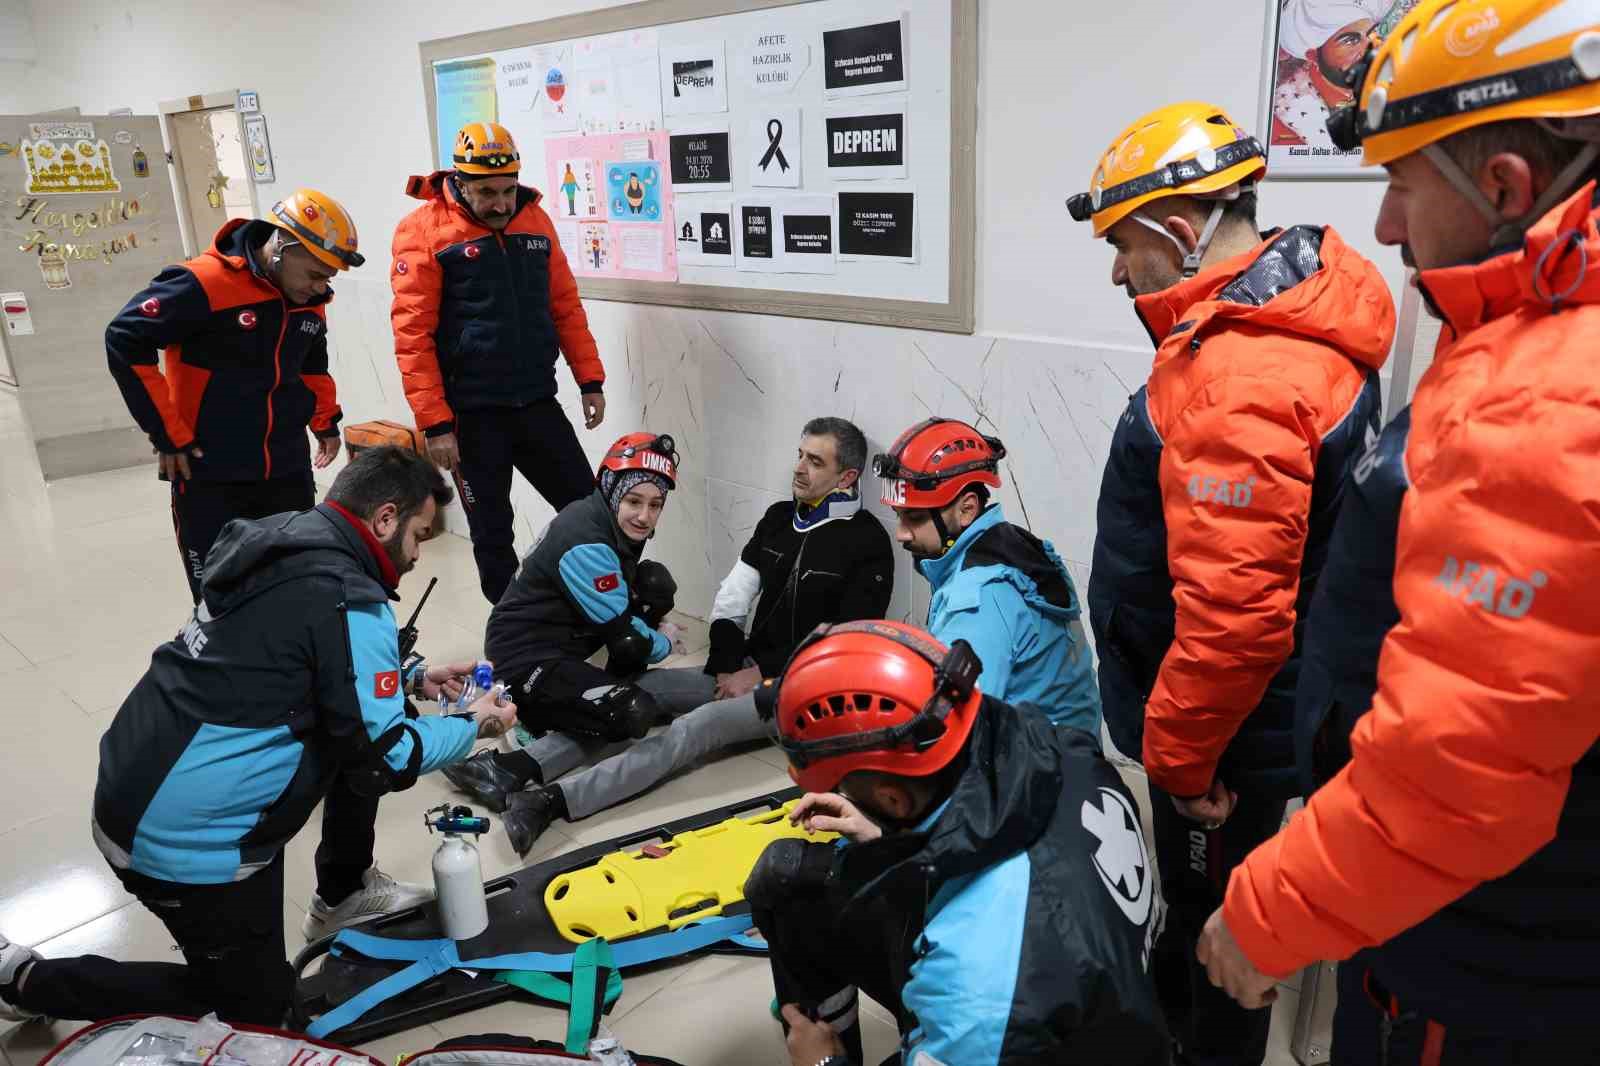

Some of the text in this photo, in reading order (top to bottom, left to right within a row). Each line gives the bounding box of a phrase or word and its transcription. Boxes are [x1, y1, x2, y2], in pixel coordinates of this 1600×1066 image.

[758, 34, 786, 47] AFETE
[752, 52, 792, 65] HAZIRLIK
[1457, 78, 1519, 111] PETZL
[833, 128, 897, 154] DEPREM
[688, 165, 710, 179] 20:55
[526, 239, 548, 250] AFAD
[642, 451, 671, 477] UMKE
[1186, 474, 1255, 509] AFAD
[1433, 555, 1540, 619] AFAD
[1189, 830, 1208, 878] AFAD
